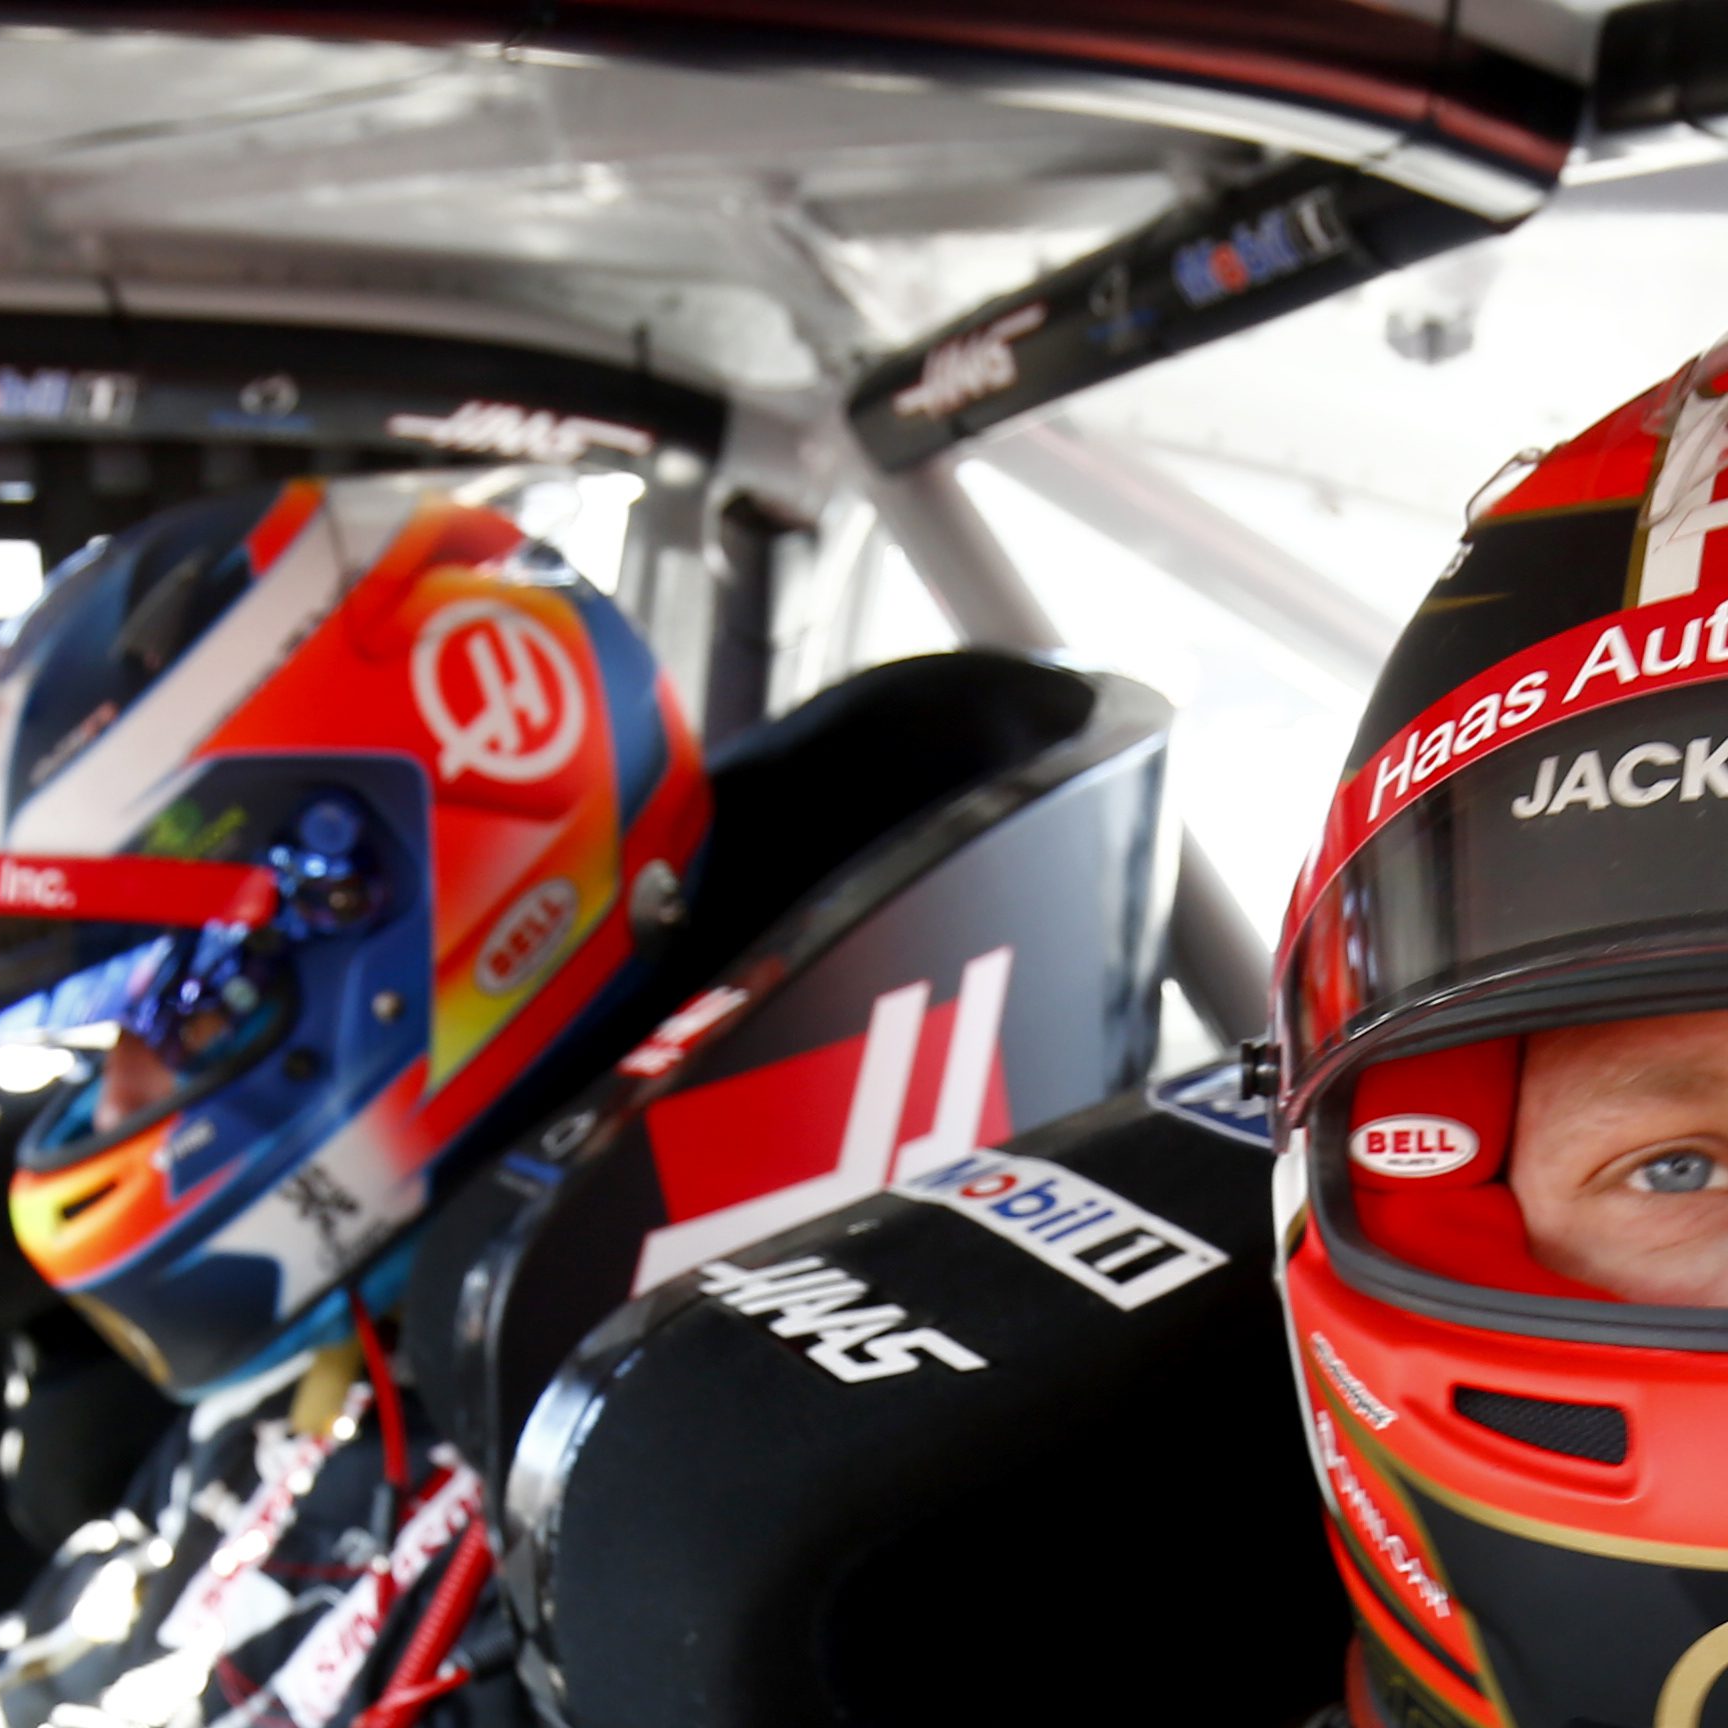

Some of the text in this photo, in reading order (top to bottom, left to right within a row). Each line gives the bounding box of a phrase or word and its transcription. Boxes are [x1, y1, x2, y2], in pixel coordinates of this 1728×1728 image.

[1368, 670, 1549, 822] Haas
[1367, 1130, 1457, 1153] BELL
[908, 1158, 1116, 1246] Mobil
[698, 1256, 990, 1383] HAAS
